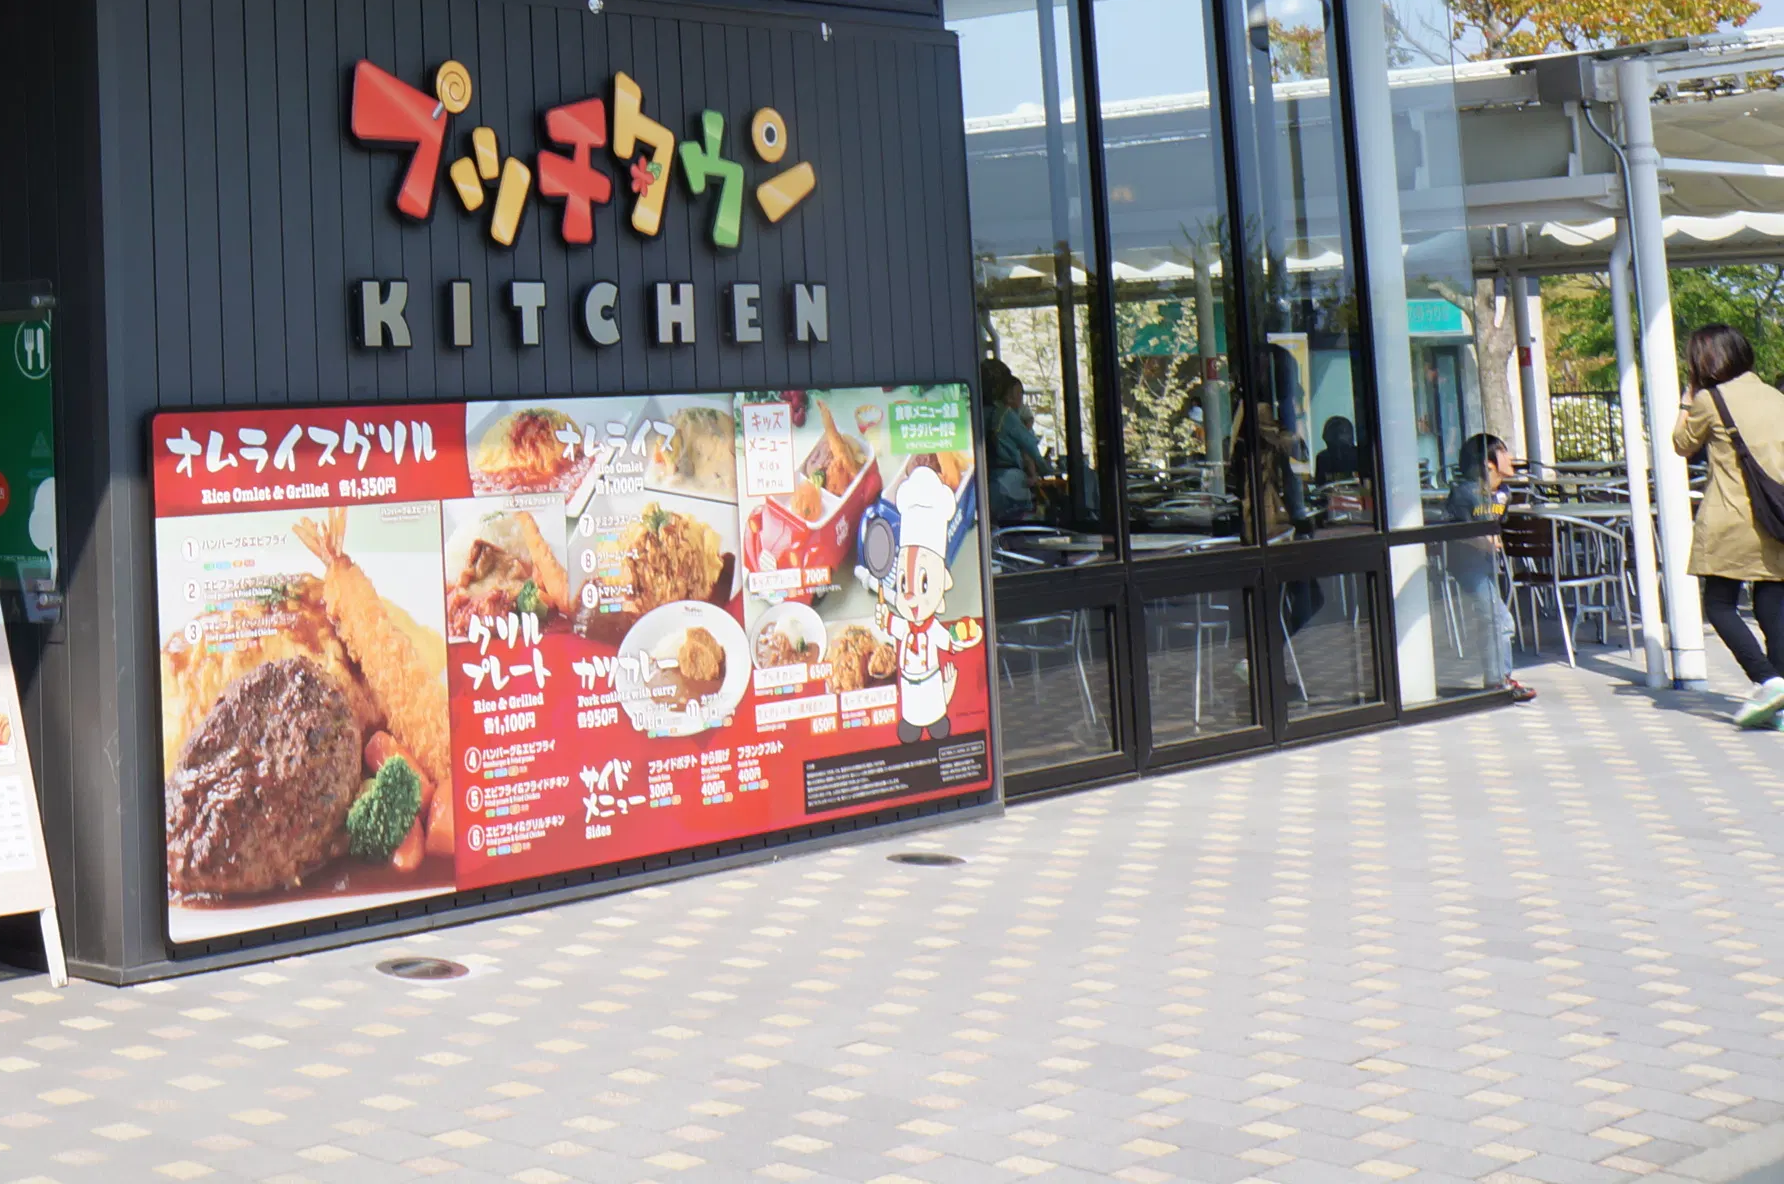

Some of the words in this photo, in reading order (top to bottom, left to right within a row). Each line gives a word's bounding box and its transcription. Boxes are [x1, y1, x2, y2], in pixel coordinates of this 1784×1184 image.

[361, 279, 828, 348] KITCHEN
[751, 411, 784, 431] キッズ
[165, 419, 437, 478] オムライスグリル
[554, 419, 677, 462] オムライス
[748, 437, 789, 453] メニュー
[201, 487, 231, 504] Rice
[232, 484, 271, 502] Omlet
[272, 484, 284, 500] &
[285, 481, 330, 499] Grilled
[468, 612, 544, 656] グリル
[462, 647, 552, 691] プレート
[572, 649, 680, 691] カツカレー
[473, 698, 497, 714] Rice
[508, 692, 544, 710] Grilled
[577, 693, 600, 708] Pork
[652, 684, 677, 698] curry
[579, 758, 632, 792] サイド
[582, 792, 646, 823] メニュー
[585, 825, 611, 840] Sides
